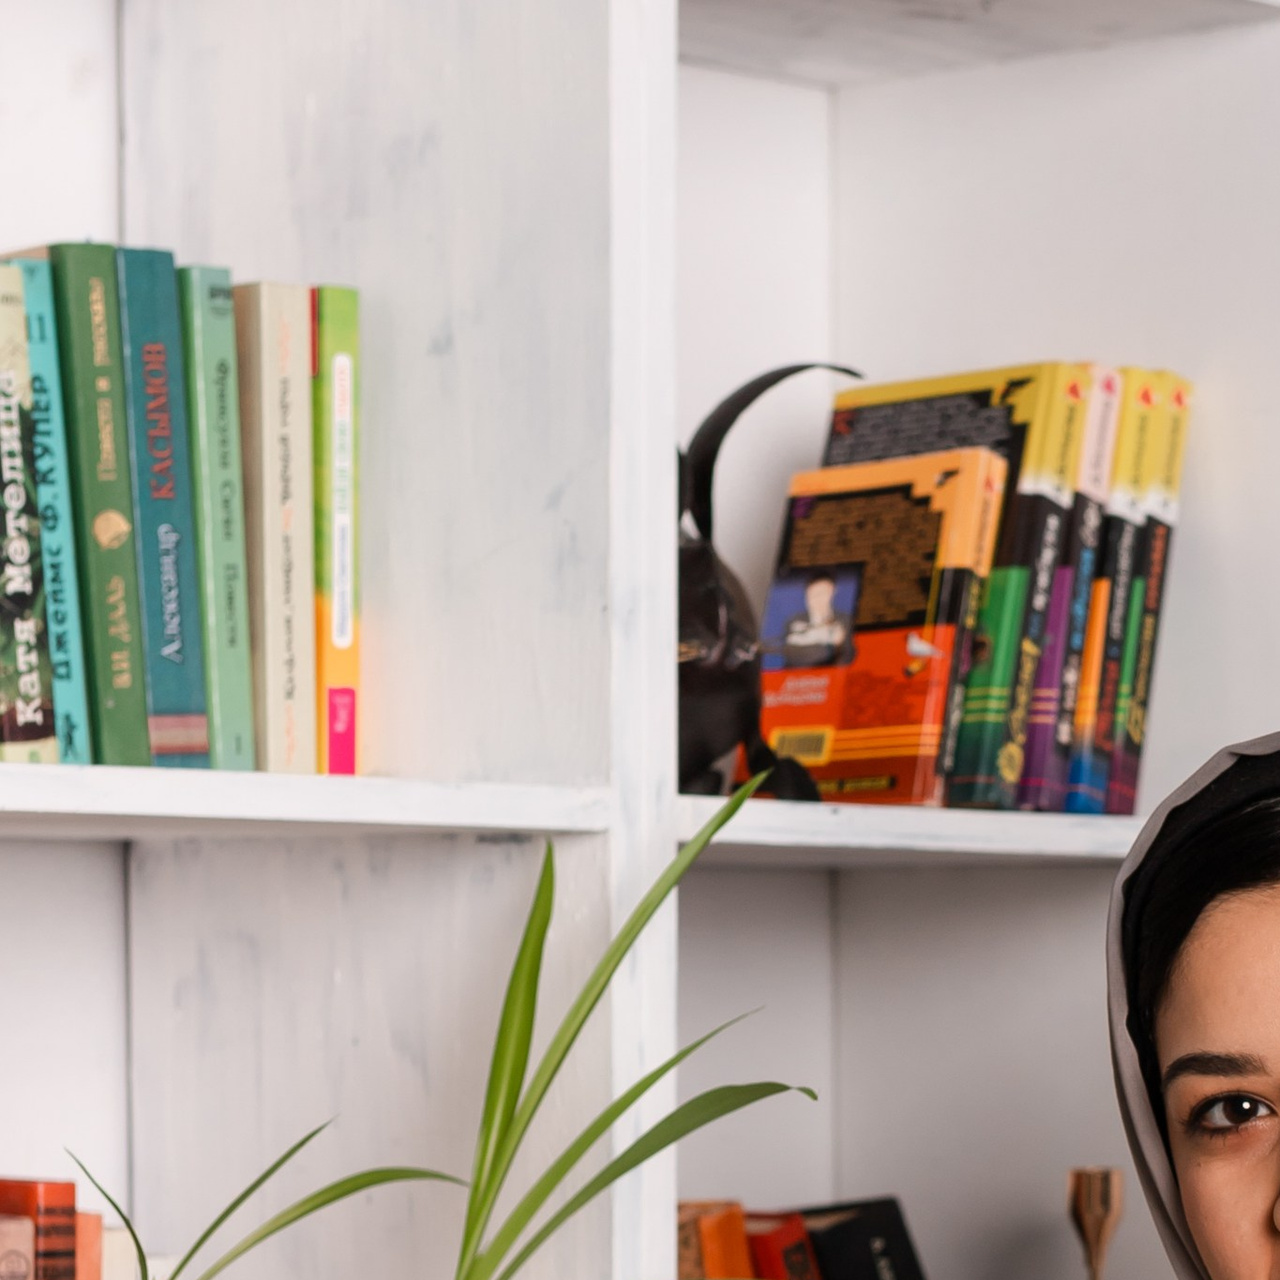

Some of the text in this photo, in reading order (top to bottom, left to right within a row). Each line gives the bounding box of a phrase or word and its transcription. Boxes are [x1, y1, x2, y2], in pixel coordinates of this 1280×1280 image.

[30, 373, 60, 489] КУПЕР
[142, 342, 185, 664] Александр КАСЫМОВ
[13, 615, 44, 727] Катя
[42, 540, 72, 682] Джеймс
